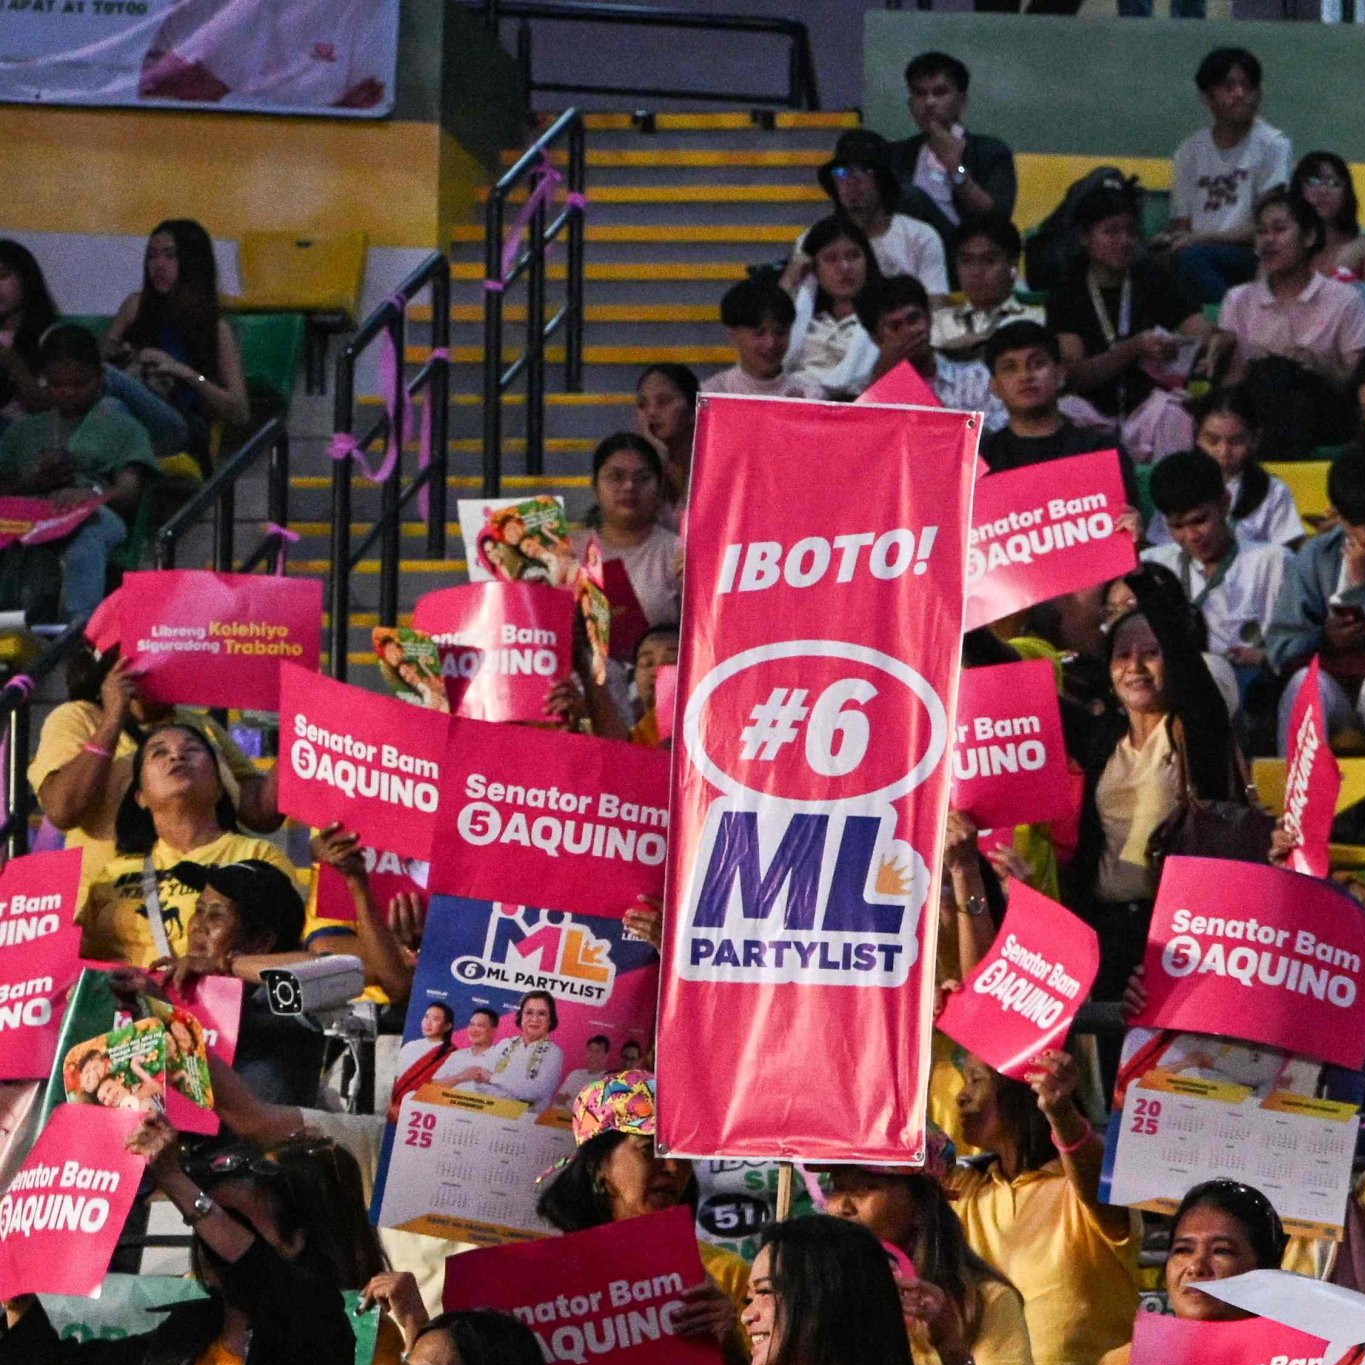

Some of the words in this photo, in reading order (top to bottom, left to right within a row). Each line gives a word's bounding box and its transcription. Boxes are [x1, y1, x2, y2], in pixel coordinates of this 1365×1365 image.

[969, 505, 1044, 544] enator
[1050, 492, 1107, 522] Bam
[716, 526, 938, 595] IBOTO!
[988, 512, 1114, 570] AQUINO
[137, 638, 220, 654] Siguradong
[225, 640, 303, 657] Trabaho
[151, 625, 206, 639] Libreng
[208, 621, 288, 638] Kolehiyo
[501, 624, 558, 647] Bam
[295, 713, 376, 762] Senator
[381, 744, 439, 779] Bam
[739, 678, 878, 778] #6
[975, 715, 1040, 741] Bam
[317, 754, 440, 814] AQUINO
[465, 773, 594, 814] Senator
[597, 795, 669, 828] Bam
[500, 813, 667, 866] AQUINO
[692, 812, 906, 934] ML
[11, 894, 62, 913] Bam
[689, 938, 903, 973] PARTYLIST
[1172, 908, 1290, 951] Senator
[1294, 929, 1361, 974] Bam
[486, 969, 510, 983] ML
[515, 972, 605, 999] PARTYLIST
[1001, 933, 1055, 985] Senator
[1047, 964, 1081, 1000] Bam
[1196, 946, 1357, 1008] AQUINO
[993, 972, 1065, 1031] AQUINO
[408, 1111, 436, 1131] 20
[1131, 1116, 1158, 1135] 25
[1135, 1098, 1162, 1118] 20
[405, 1130, 432, 1148] 25
[61, 1160, 120, 1192] Bam
[610, 1271, 684, 1309] Bam
